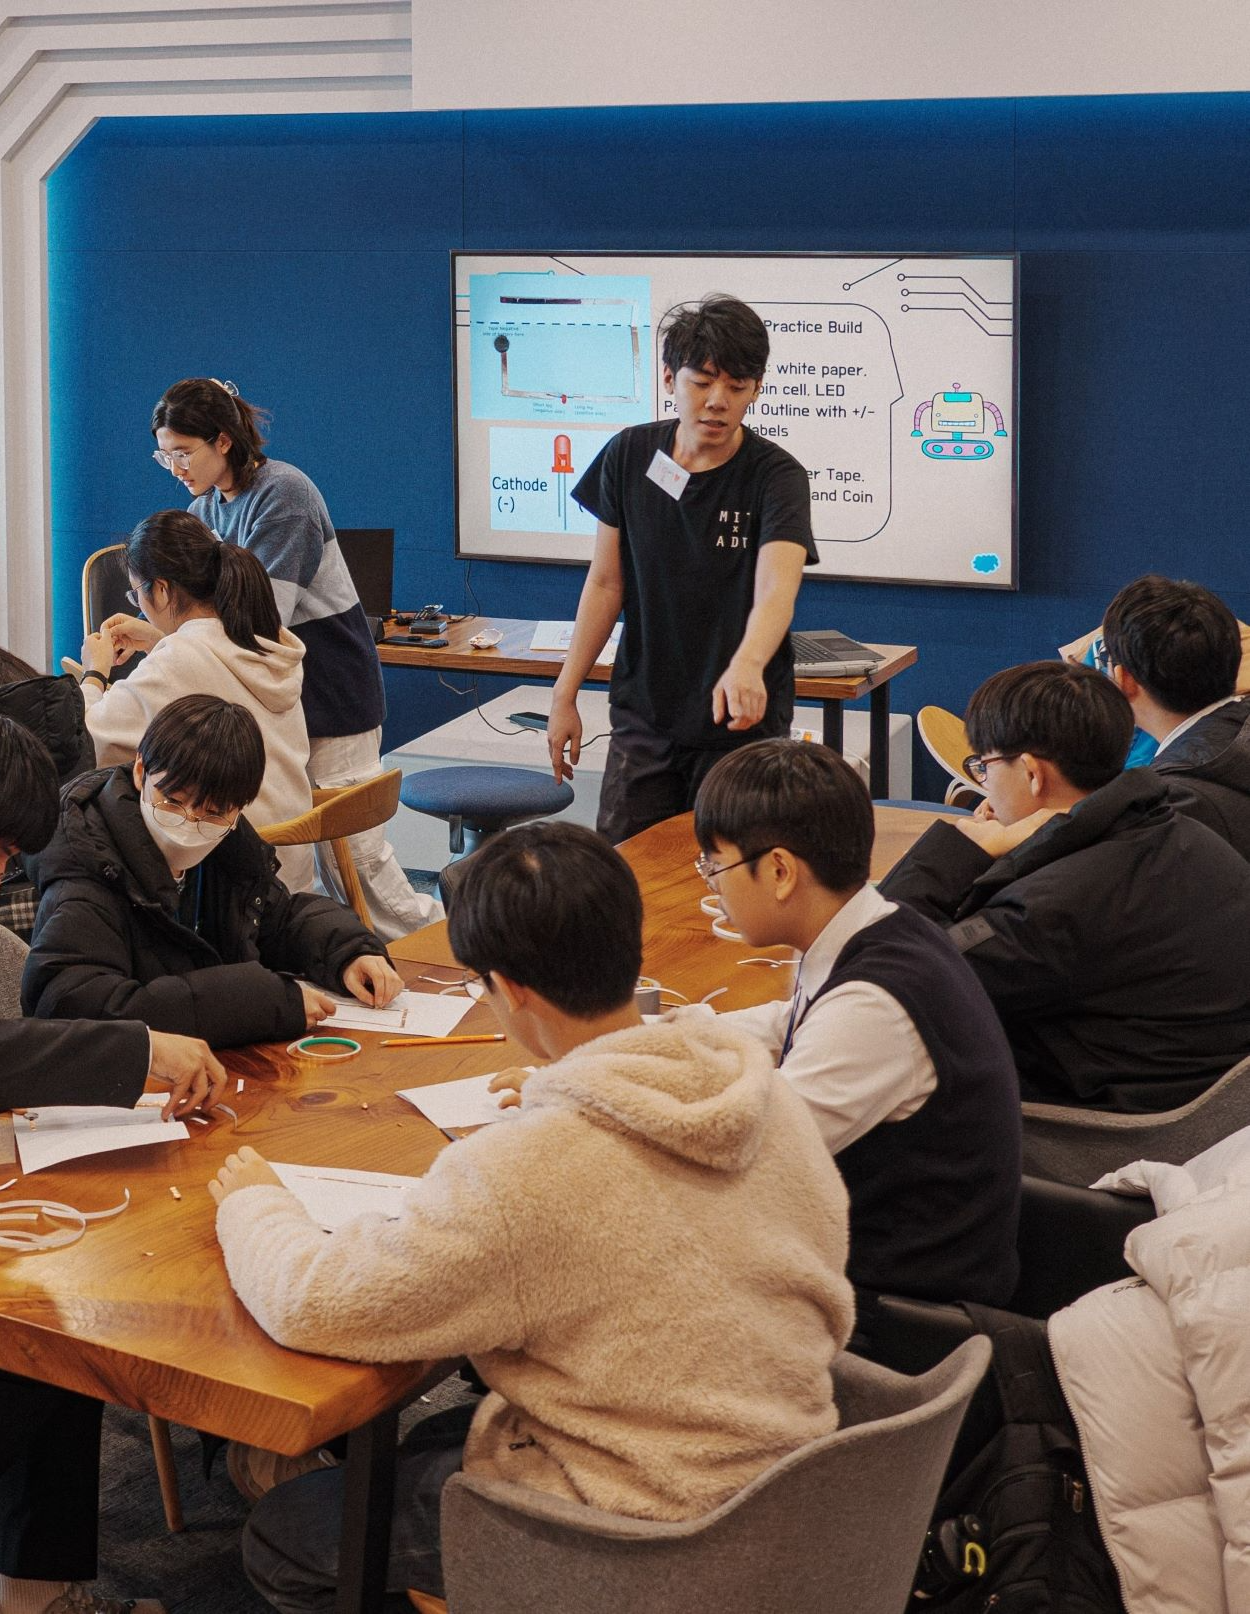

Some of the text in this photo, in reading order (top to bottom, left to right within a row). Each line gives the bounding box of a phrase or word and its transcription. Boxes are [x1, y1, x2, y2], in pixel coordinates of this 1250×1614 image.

[764, 320, 863, 334] Practice Build
[777, 362, 816, 375] white
[758, 382, 777, 395] oin
[816, 384, 845, 397] LED
[761, 403, 810, 417] Outline
[816, 405, 847, 418] with
[852, 406, 876, 419] +/-
[492, 476, 548, 492] Cathode
[811, 490, 873, 503] and Coin
[497, 496, 515, 512] (-)
[719, 510, 751, 523] MI
